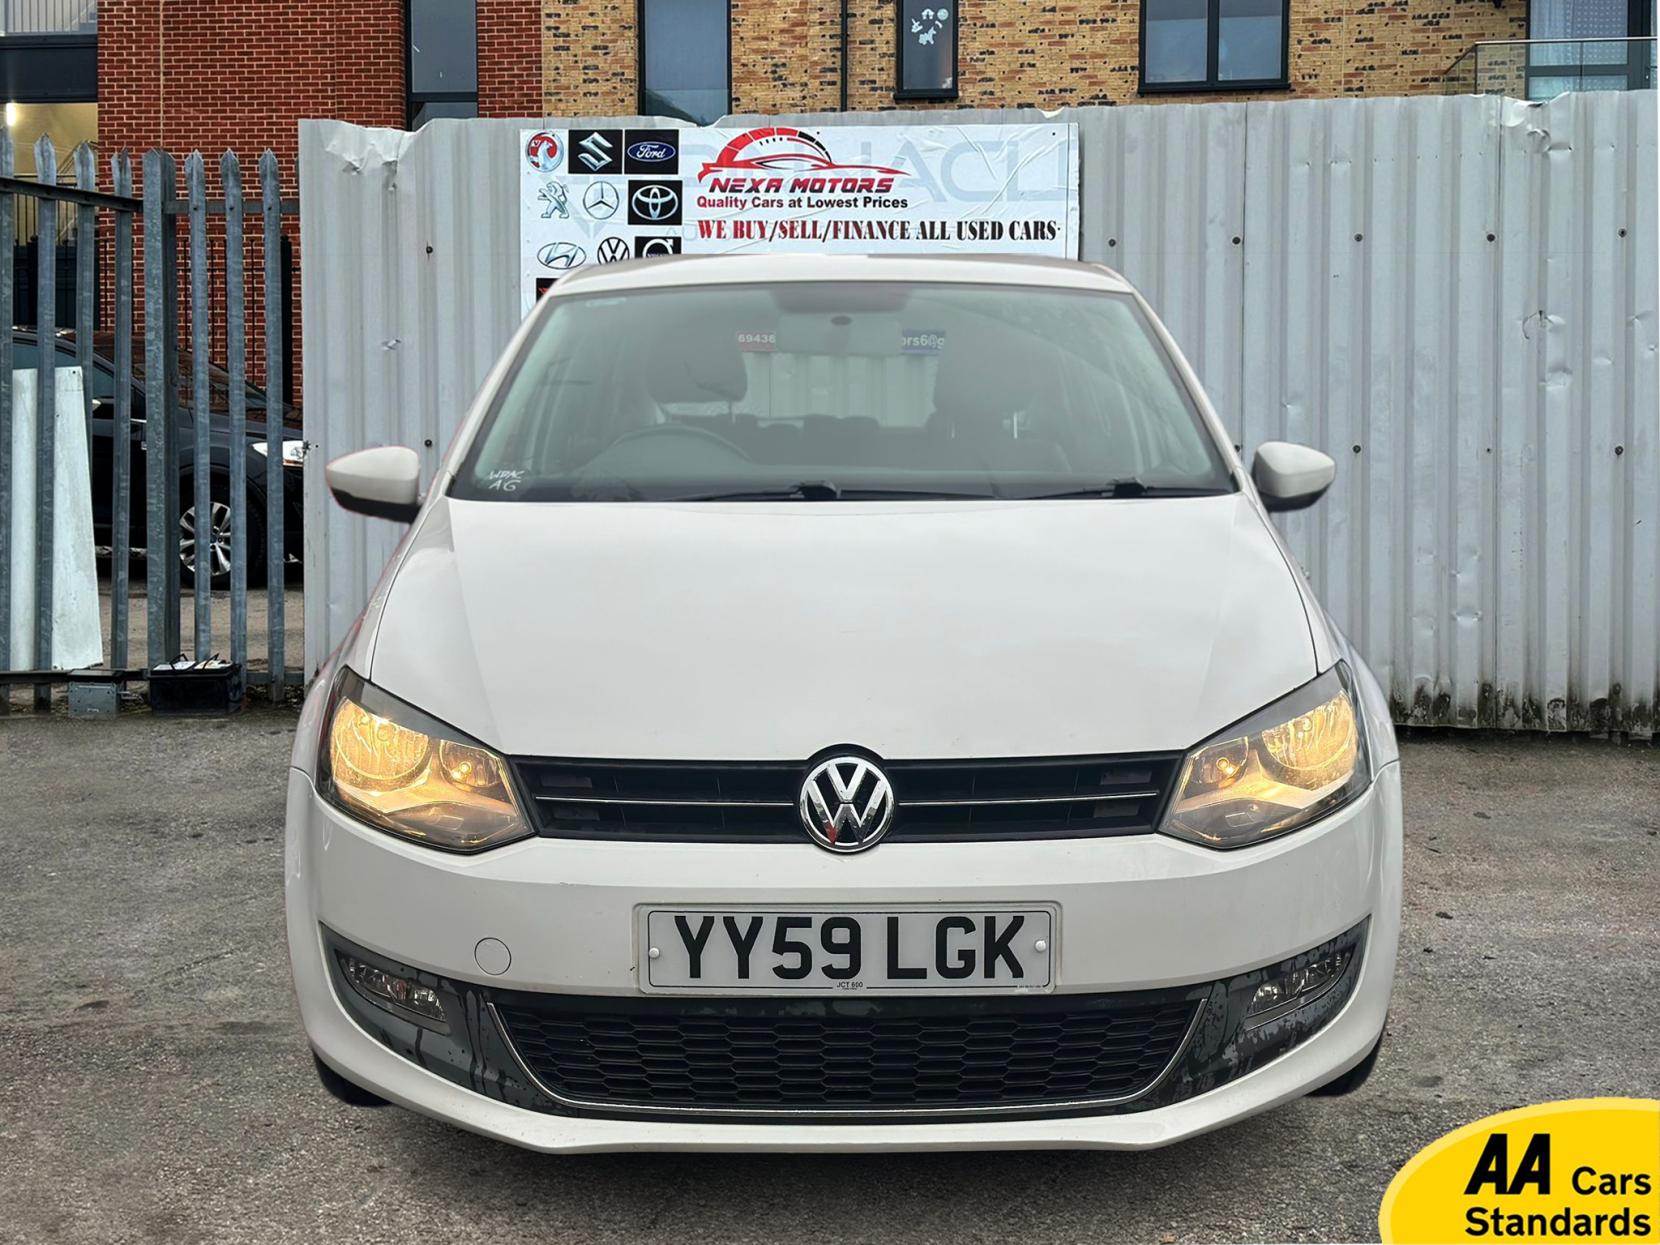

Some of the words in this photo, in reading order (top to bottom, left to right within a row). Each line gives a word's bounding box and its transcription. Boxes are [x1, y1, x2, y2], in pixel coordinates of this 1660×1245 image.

[636, 144, 667, 159] Ford
[708, 178, 784, 194] NEXA
[789, 178, 895, 194] MOTORS
[697, 196, 747, 211] Quality
[751, 197, 784, 209] Cars
[788, 198, 803, 209] at
[807, 197, 859, 209] Lowest
[863, 197, 909, 209] Prices
[697, 220, 727, 240] WE
[916, 220, 951, 241] ALL
[956, 220, 1004, 241] USED
[1008, 220, 1057, 241] CARS
[674, 915, 862, 980] YY59
[886, 915, 1025, 980] LGK
